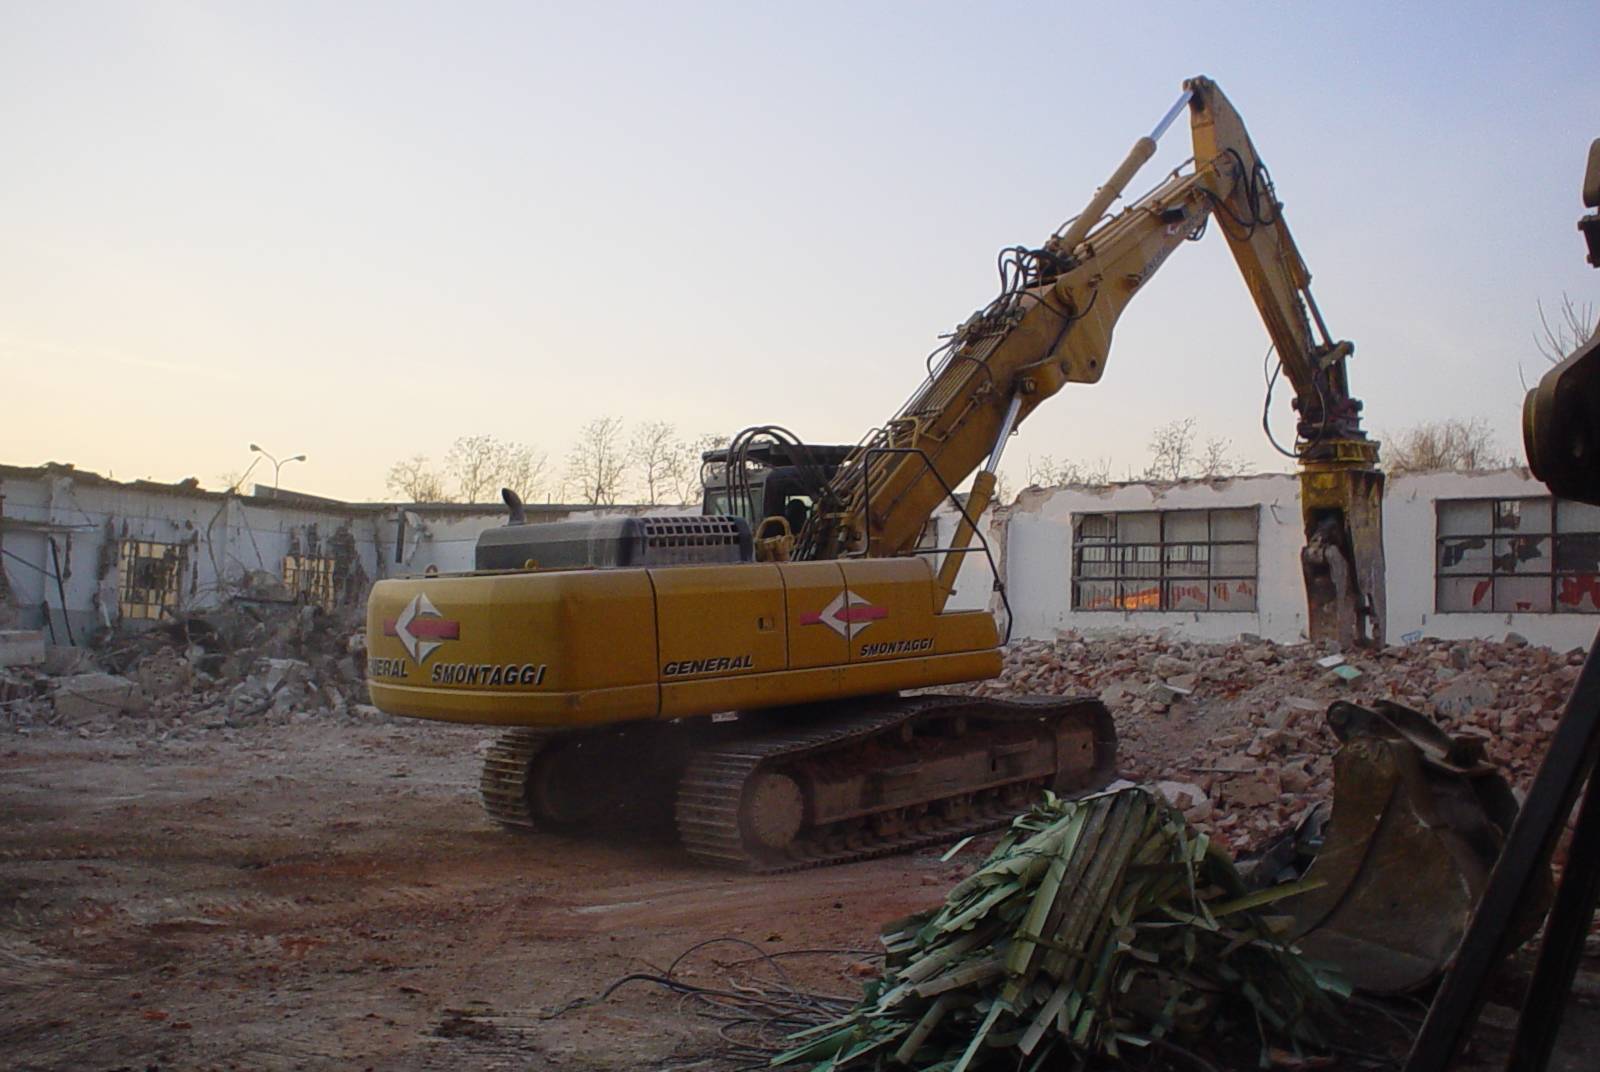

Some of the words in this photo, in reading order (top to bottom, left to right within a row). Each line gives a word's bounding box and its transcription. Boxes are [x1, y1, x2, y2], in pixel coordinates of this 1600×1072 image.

[663, 655, 754, 677] GENERAL
[861, 637, 935, 657] SMONTAGGI
[432, 662, 547, 686] SMONTAGGI
